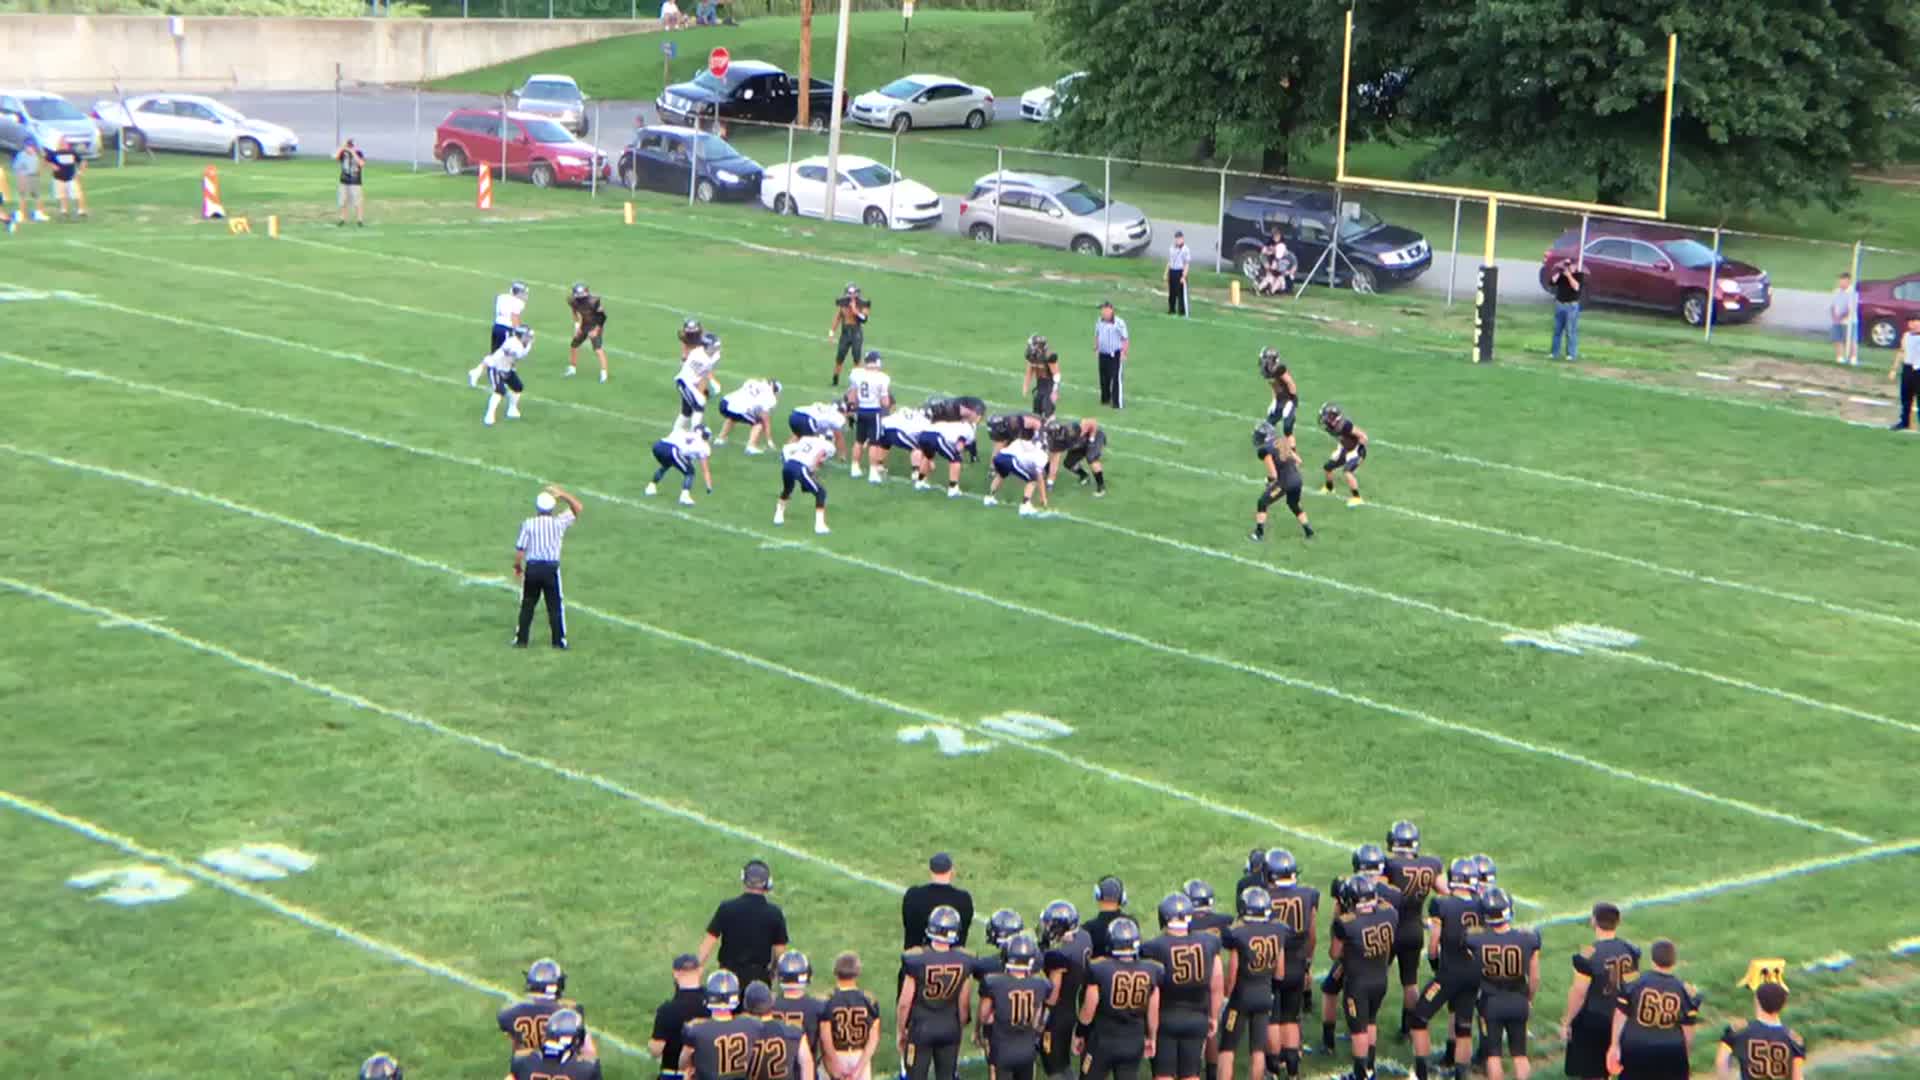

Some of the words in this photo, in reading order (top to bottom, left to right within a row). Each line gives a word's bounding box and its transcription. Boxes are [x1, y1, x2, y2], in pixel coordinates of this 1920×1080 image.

[1171, 943, 1205, 985] 51
[1248, 935, 1281, 973] 31
[1481, 944, 1523, 978] 50
[924, 963, 964, 1000] 57
[1111, 970, 1151, 1009] 66
[832, 1007, 868, 1045] 35
[1009, 990, 1035, 1027] 11
[1637, 987, 1681, 1029] 68
[714, 1032, 748, 1074] 12
[1747, 1039, 1791, 1080] 58
